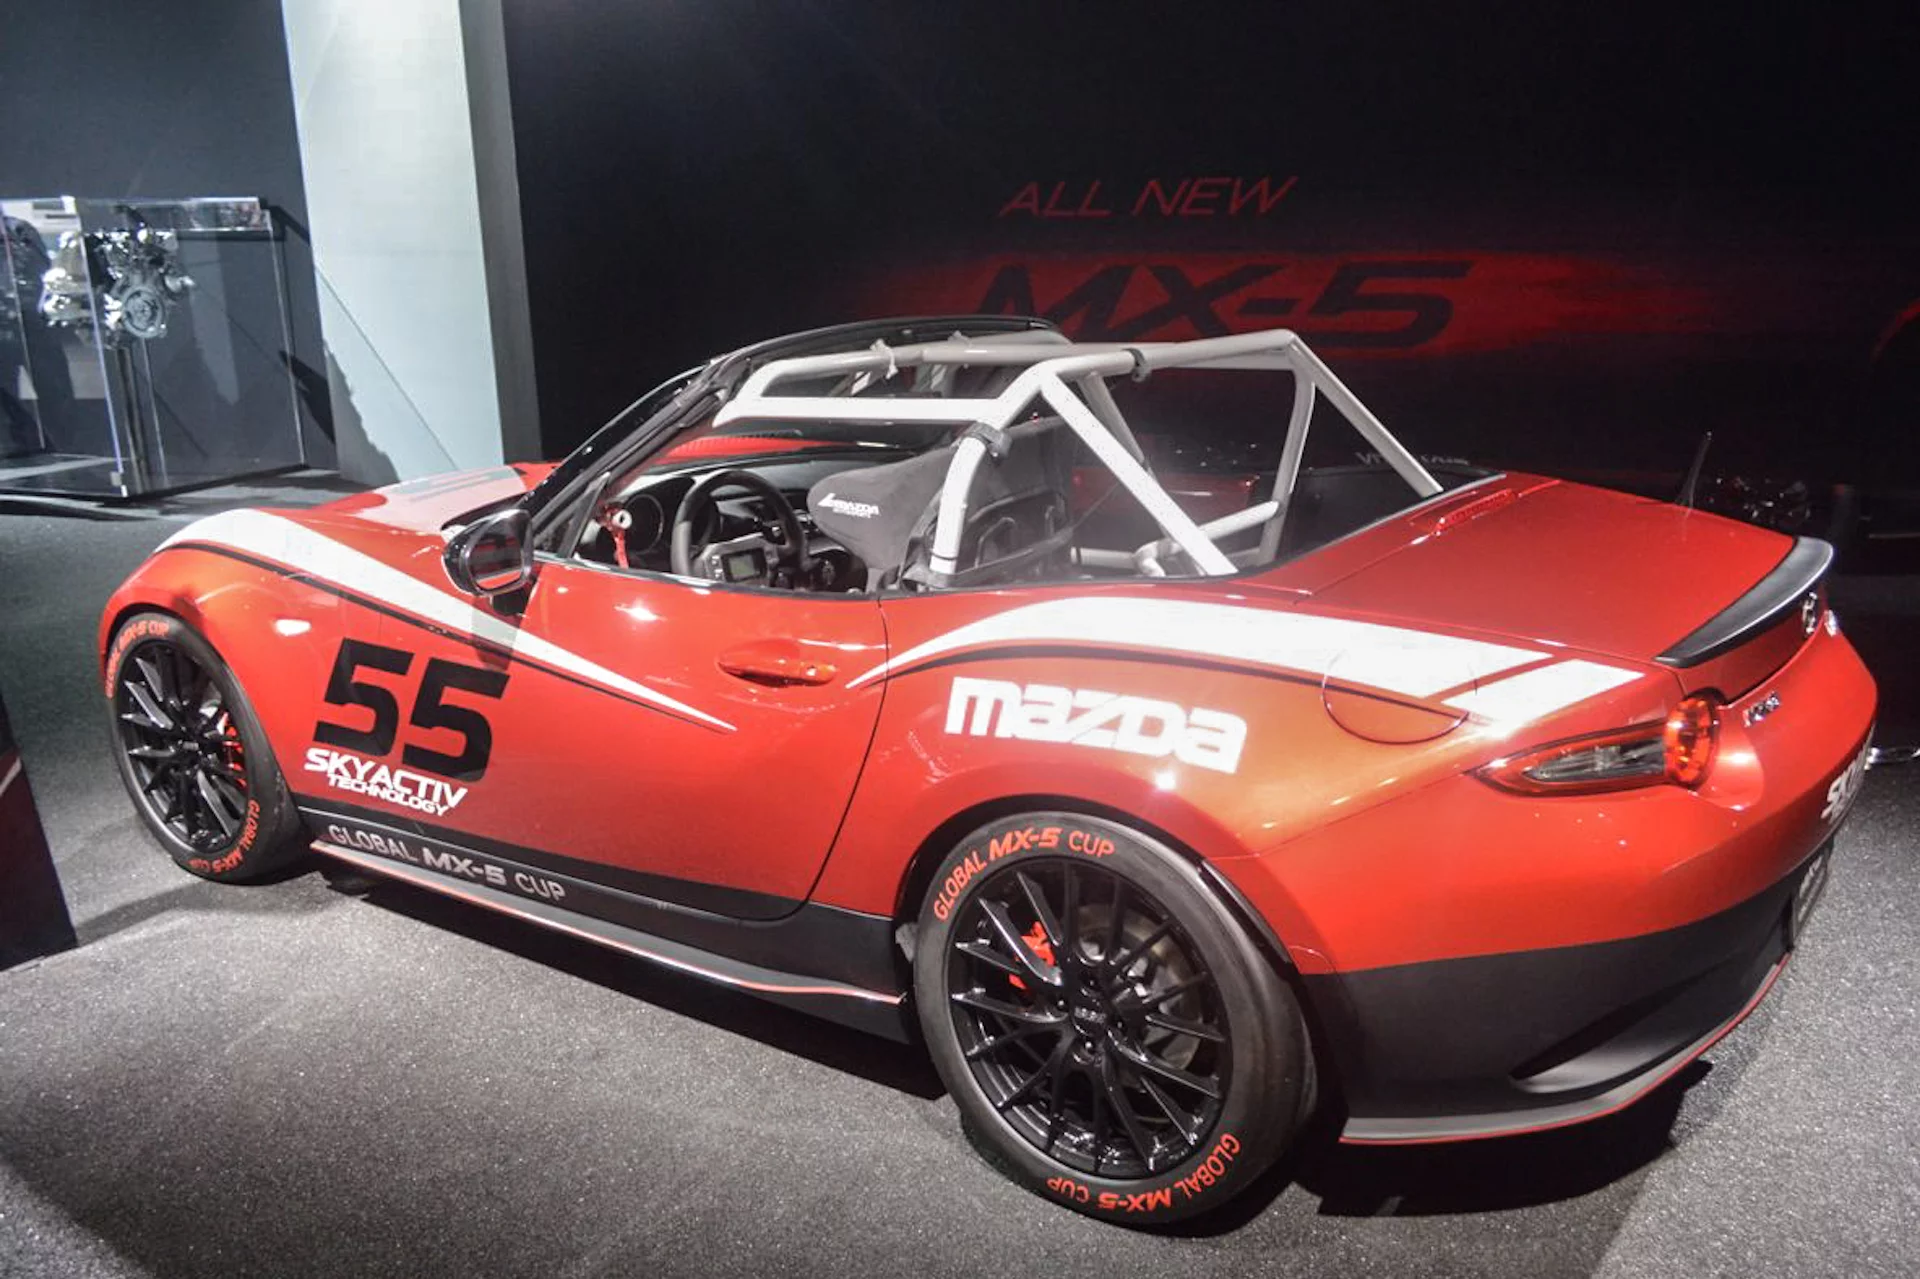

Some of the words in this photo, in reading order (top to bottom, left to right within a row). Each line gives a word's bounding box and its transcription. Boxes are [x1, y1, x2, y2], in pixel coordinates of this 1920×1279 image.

[998, 181, 1112, 218] ALL
[1129, 175, 1299, 216] NEW
[971, 260, 1474, 348] MX-5
[312, 637, 510, 782] 55
[304, 747, 468, 808] SKYACTIV
[327, 773, 450, 817] TECHNOLOGY
[328, 824, 419, 863] GLOBAL
[421, 847, 507, 887] MX-5
[514, 872, 566, 901] CUP
[933, 851, 988, 922] GLOBAL
[987, 826, 1064, 862] MX-5
[1068, 831, 1115, 859] CUP
[1046, 1177, 1091, 1204] CUP
[1174, 1132, 1241, 1199] GLOBAL
[1098, 1187, 1172, 1213] MX-5
